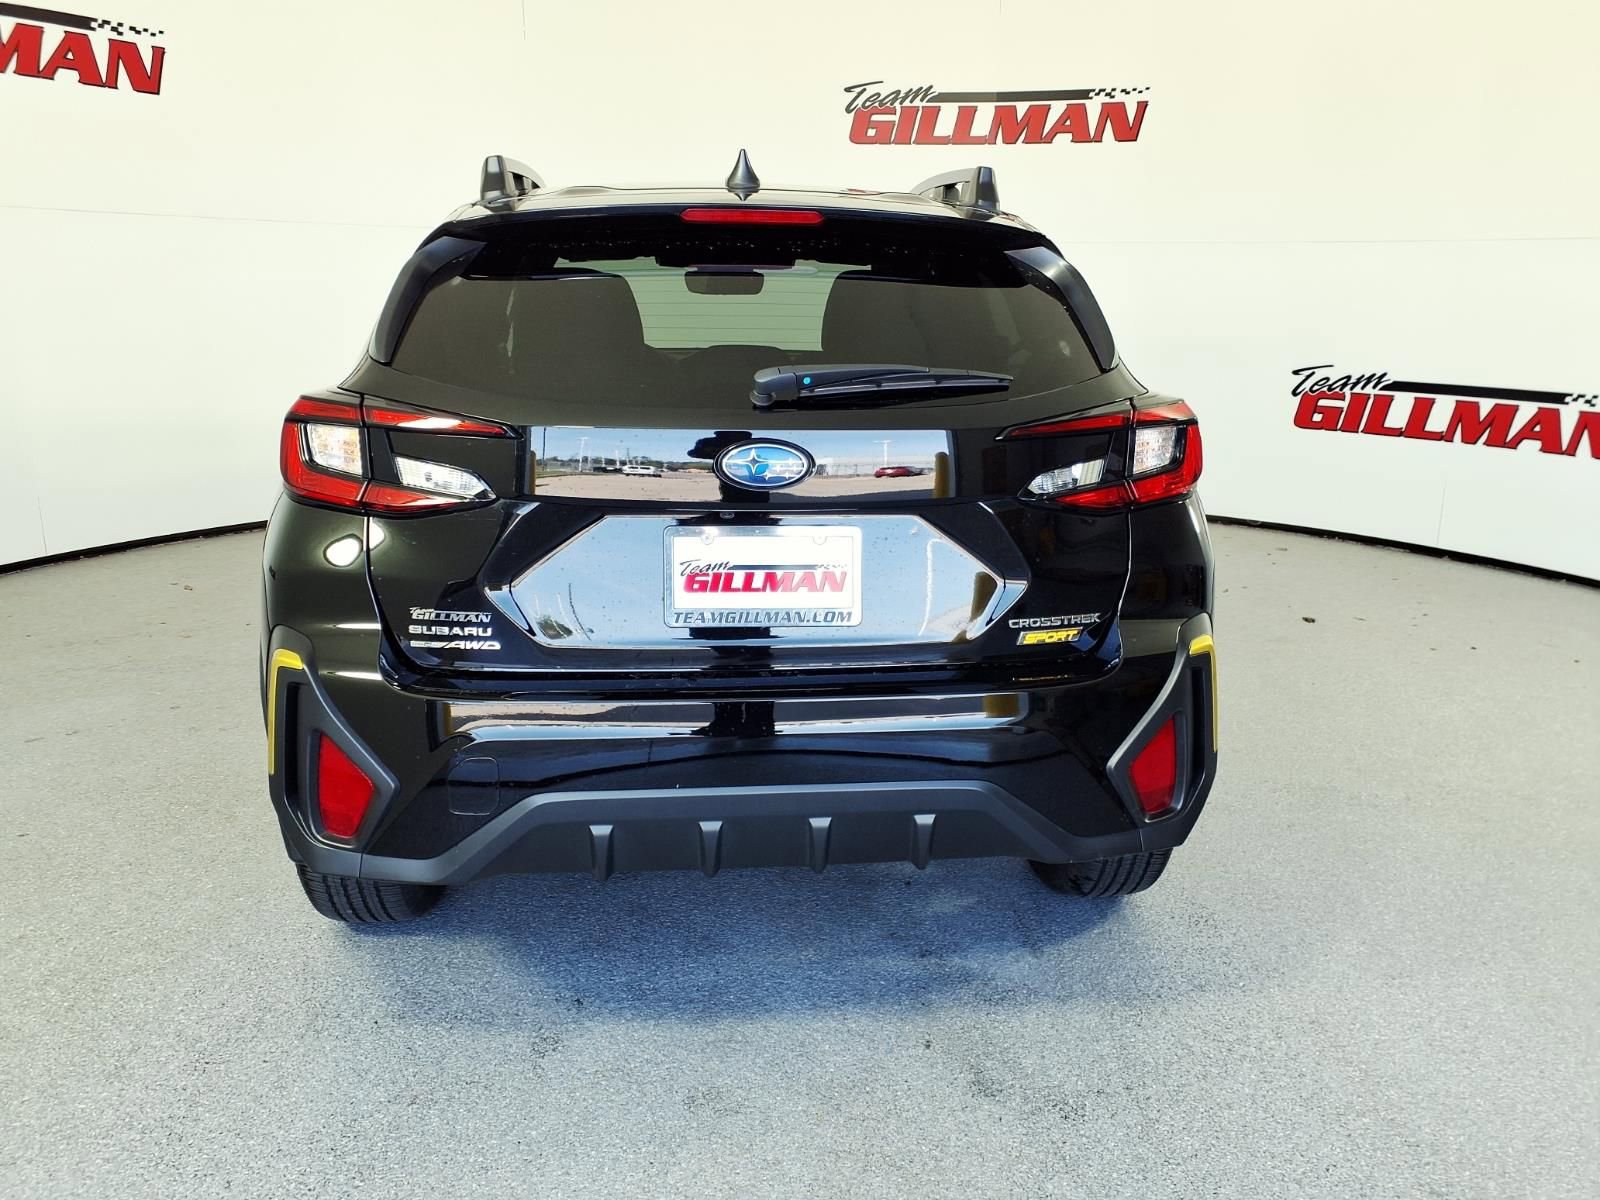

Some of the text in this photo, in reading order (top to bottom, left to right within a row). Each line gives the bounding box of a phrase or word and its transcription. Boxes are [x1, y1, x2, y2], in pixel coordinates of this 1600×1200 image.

[844, 81, 938, 114] Team
[849, 101, 1148, 145] GILLMAN
[1291, 365, 1394, 397] Team
[680, 559, 731, 577] Team
[683, 572, 847, 592] GILLMAN
[411, 612, 491, 622] GILLMAN
[674, 611, 853, 625] TEAMGILLMAN.COM
[1008, 613, 1101, 628] CROSSTREK
[408, 625, 492, 636] SUBARU
[1023, 629, 1078, 645] SPORT
[444, 640, 501, 650] AWD
